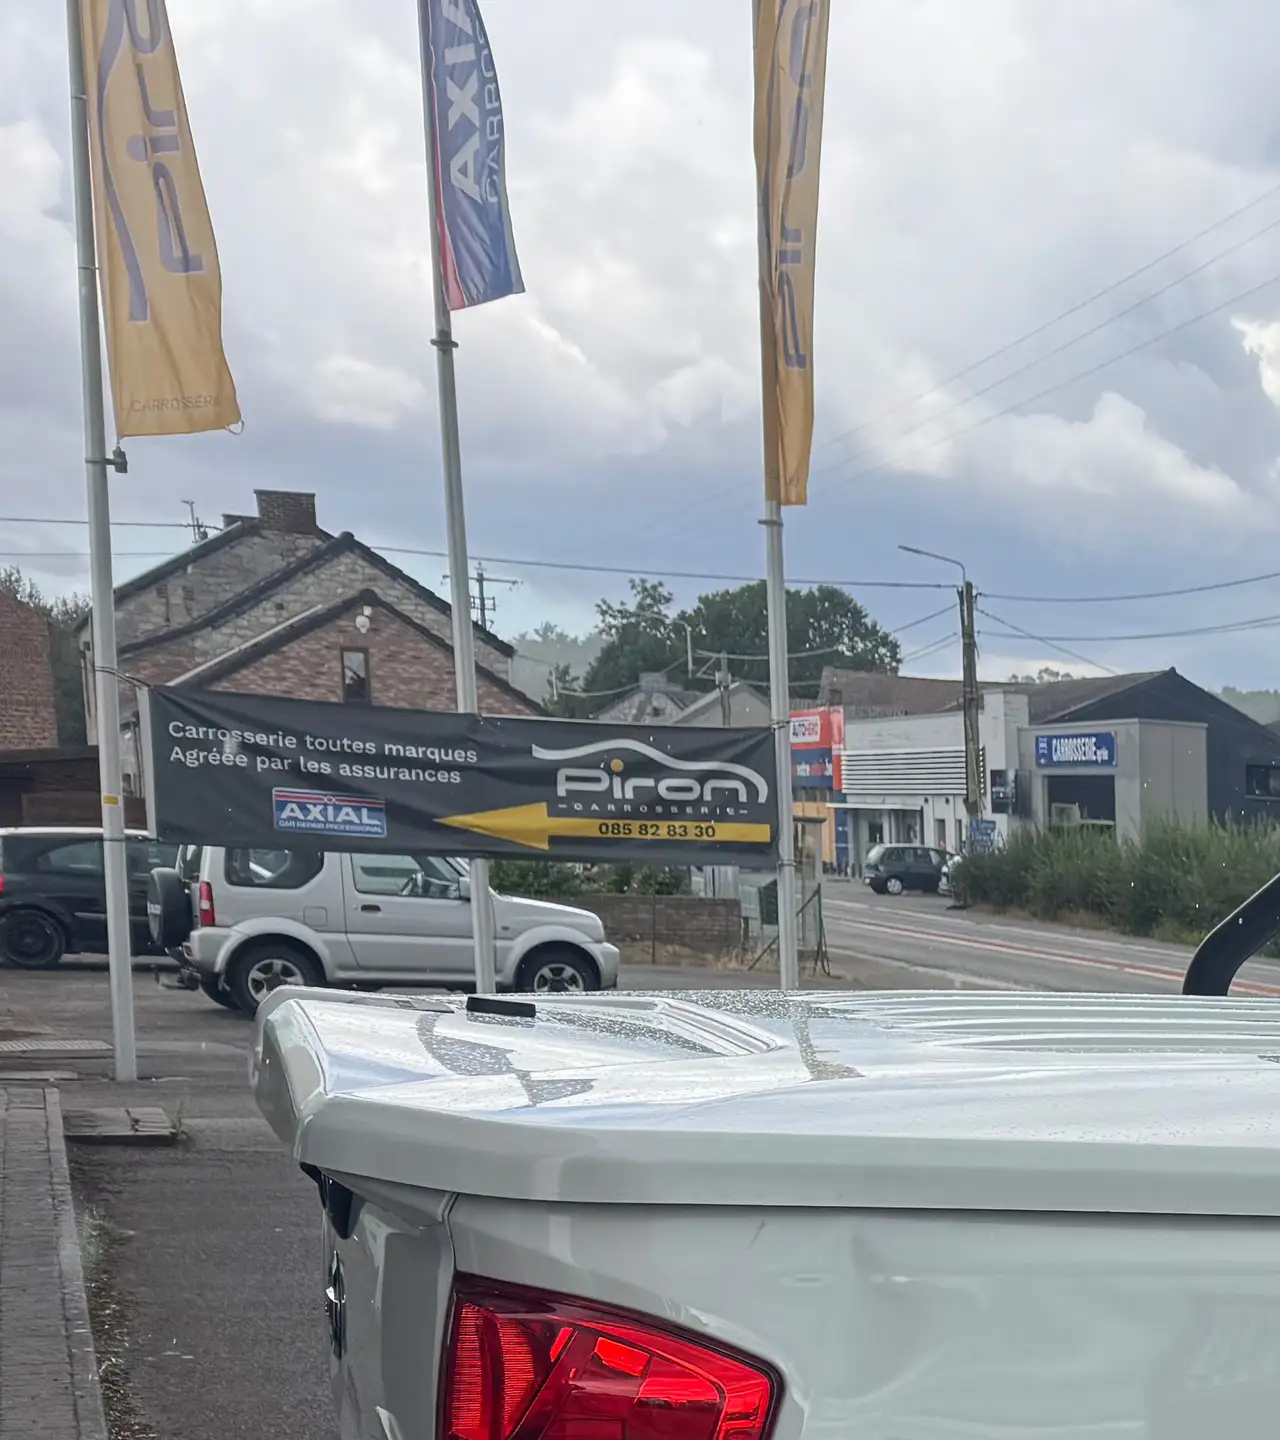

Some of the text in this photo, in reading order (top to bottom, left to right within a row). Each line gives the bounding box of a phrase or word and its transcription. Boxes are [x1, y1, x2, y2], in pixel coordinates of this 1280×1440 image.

[168, 721, 478, 764] Carrosserie toutes marques
[170, 746, 461, 784] Agréée par les assurances
[556, 758, 747, 802] Piron
[280, 802, 382, 825] AXIAL
[599, 822, 716, 838] 085 82 83 30
